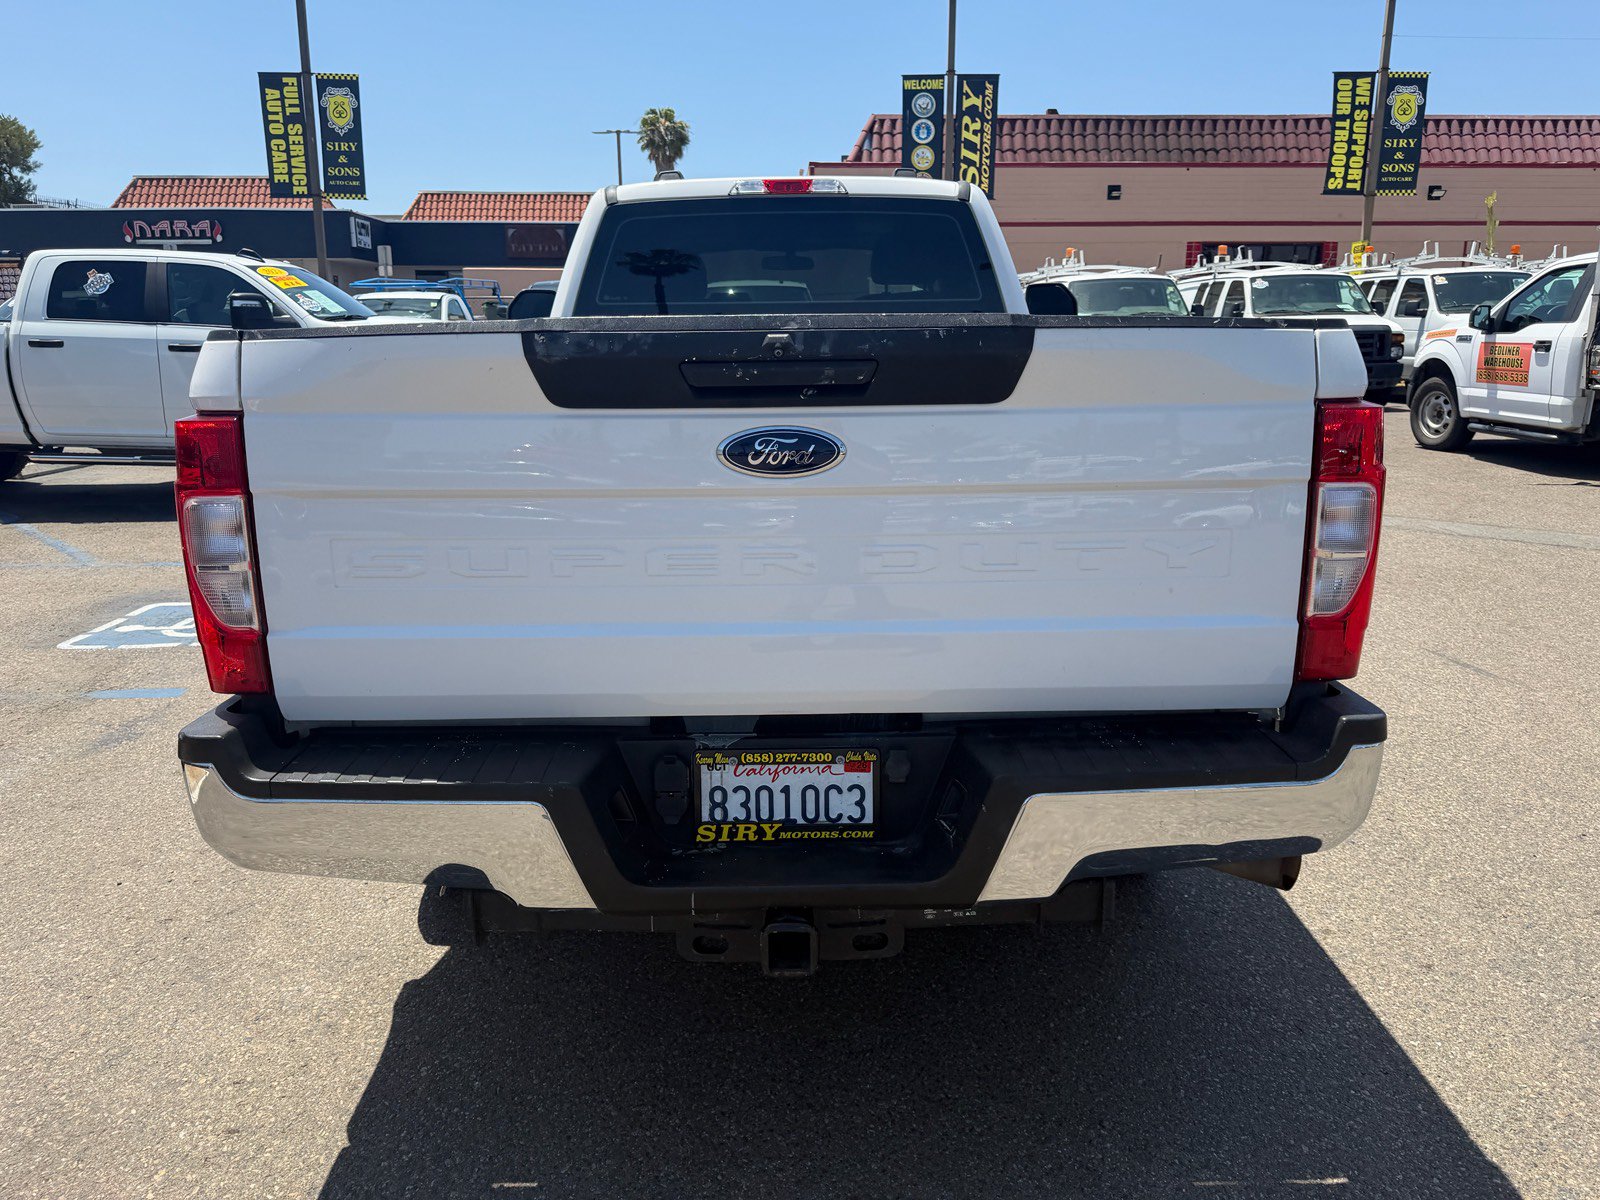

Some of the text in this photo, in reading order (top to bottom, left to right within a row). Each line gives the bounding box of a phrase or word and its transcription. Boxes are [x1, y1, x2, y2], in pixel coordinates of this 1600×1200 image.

[904, 79, 944, 90] WELCOME
[265, 88, 289, 183] AUTO CARE
[282, 77, 308, 195] FULL SERVICE
[960, 80, 982, 187] SIRY
[981, 81, 994, 193] MOTORS.COM
[1327, 79, 1353, 190] OUR TROOPS
[1346, 77, 1371, 191] WE SUPPORT
[326, 142, 357, 151] SIRY
[1384, 138, 1417, 148] SIRY
[338, 155, 348, 163] &
[1393, 151, 1405, 159] &
[327, 167, 360, 176] SONS
[1381, 163, 1415, 173] SONS
[133, 220, 211, 237] NARA
[1489, 345, 1520, 357] BEDLINER
[1483, 356, 1524, 368] WAREHOUSE
[1477, 369, 1529, 383] (858) 888-5338
[748, 437, 815, 465] Ford
[349, 537, 1221, 578] SUPER DUTY
[741, 752, 832, 764] (858) 277-7300
[845, 751, 877, 763] Chula Vista
[733, 763, 845, 783] California
[708, 784, 866, 824] 83010C3
